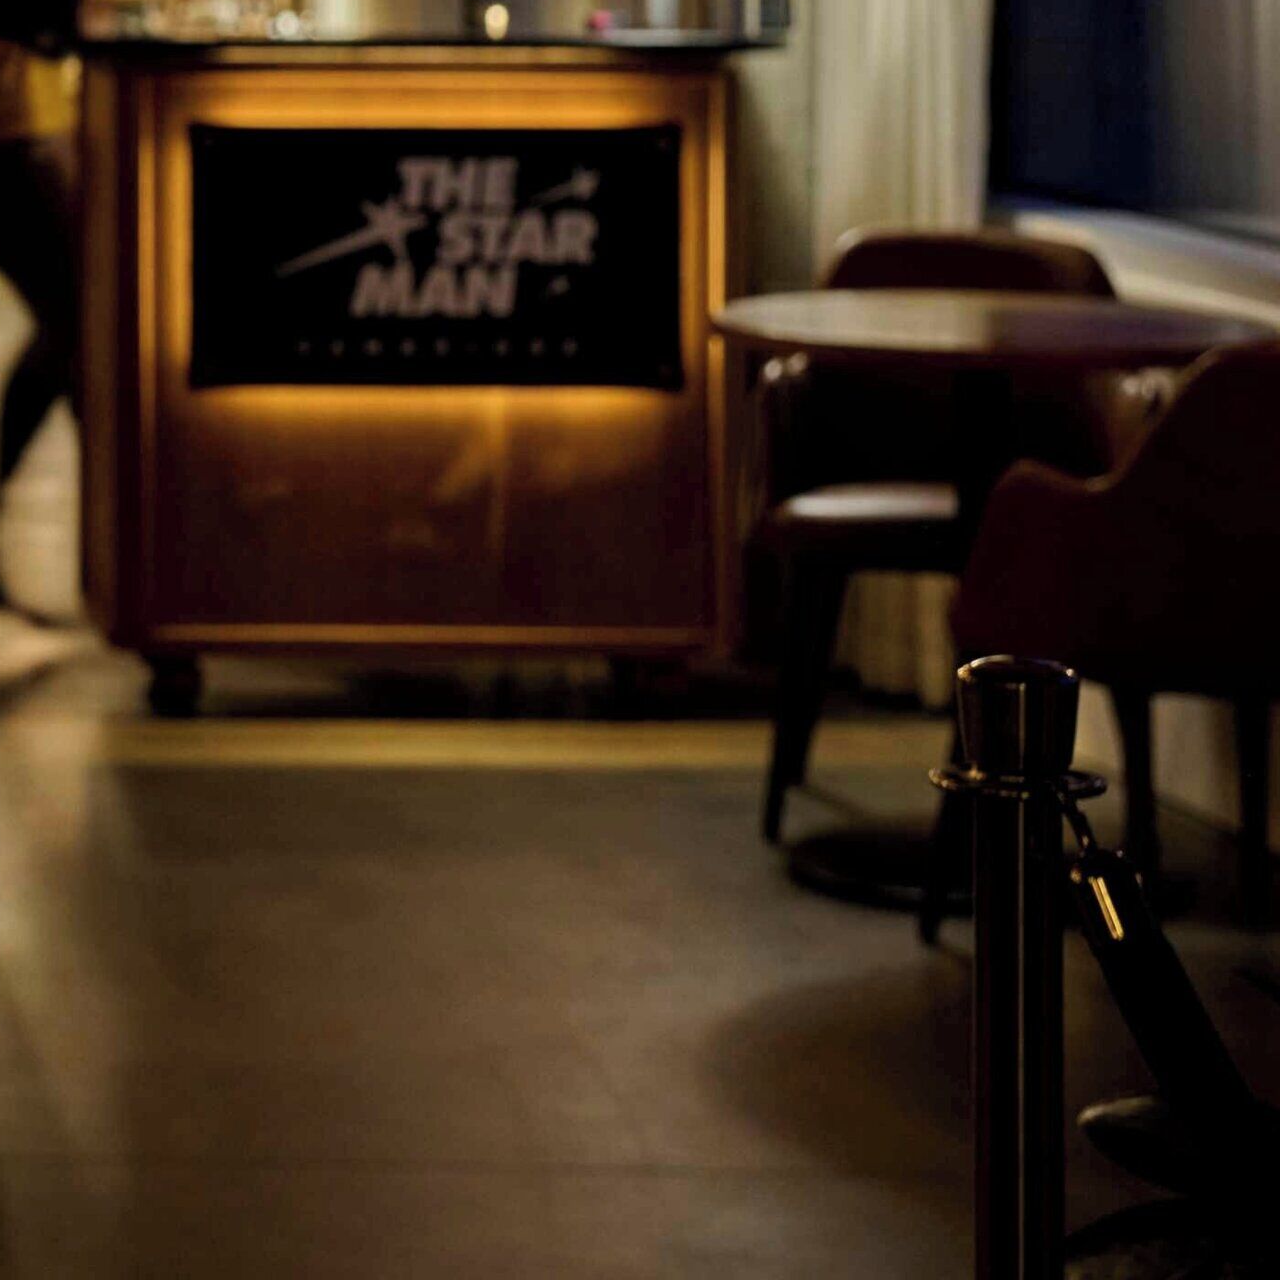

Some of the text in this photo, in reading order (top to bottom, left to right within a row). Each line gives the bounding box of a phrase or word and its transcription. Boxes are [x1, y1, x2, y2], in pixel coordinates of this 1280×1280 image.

[395, 156, 519, 210] THE
[436, 212, 597, 264] STAR
[348, 263, 519, 318] MAN
